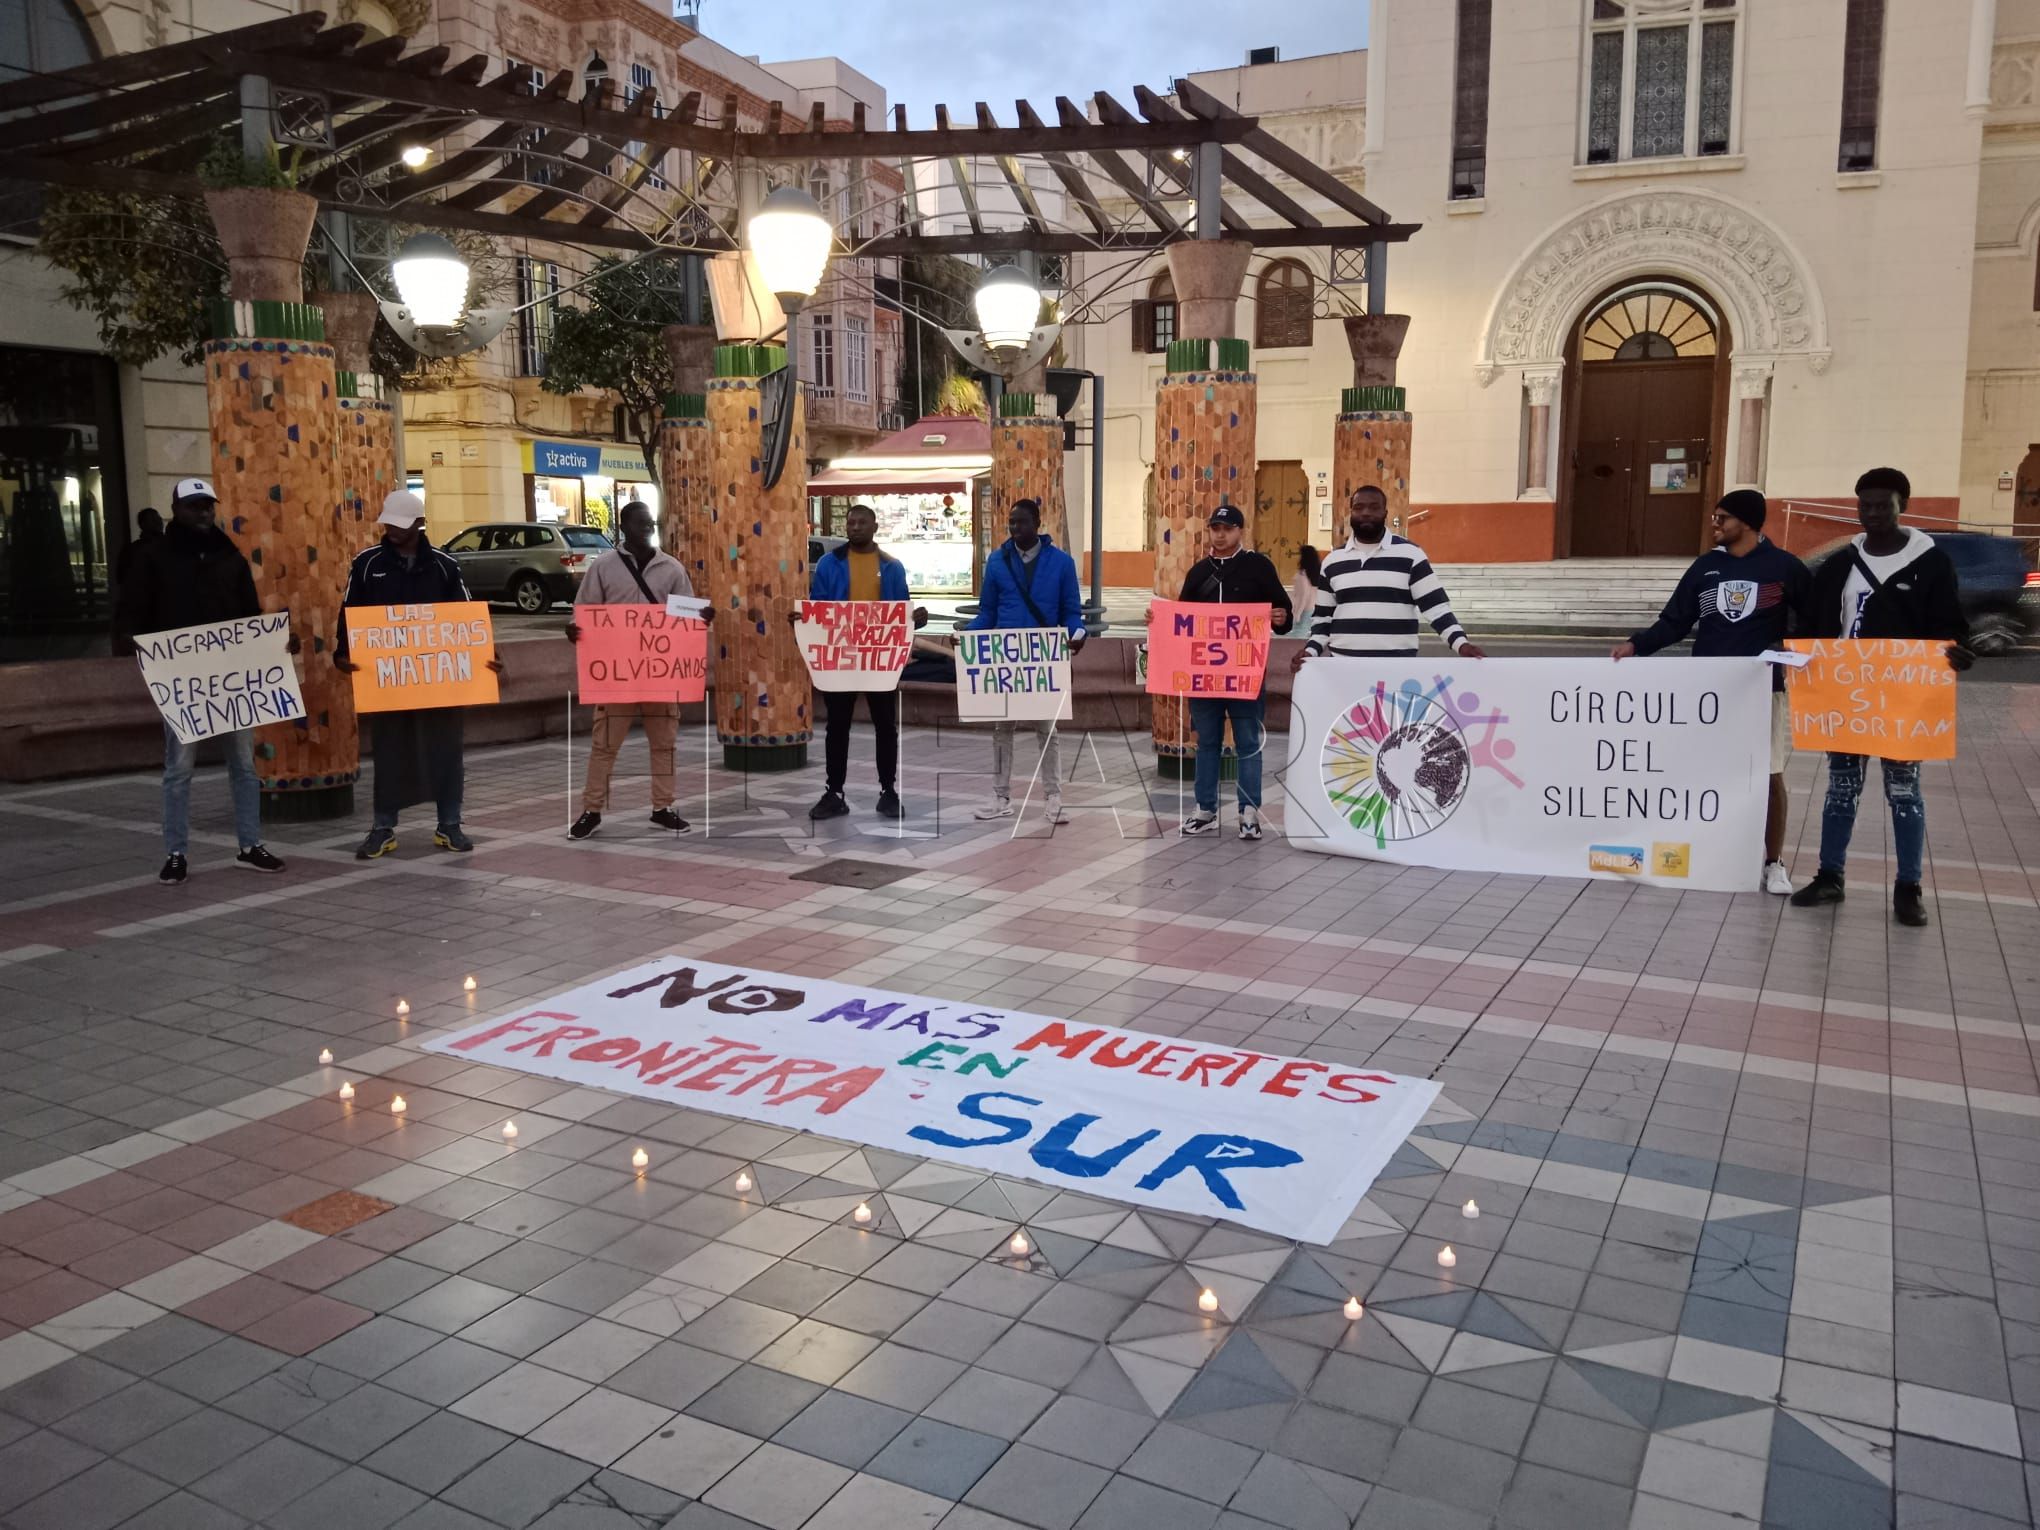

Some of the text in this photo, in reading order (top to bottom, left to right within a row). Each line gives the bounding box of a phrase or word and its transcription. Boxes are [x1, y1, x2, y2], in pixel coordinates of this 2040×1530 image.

[559, 453, 587, 468] activa
[602, 459, 634, 469] MUEBLES
[386, 604, 436, 621] LAS
[801, 601, 906, 625] MEMORIA
[1173, 613, 1266, 640] MIGRAR
[350, 619, 488, 649] FRONTERAS
[640, 631, 671, 654] NO
[822, 624, 911, 647] TARAJAL
[808, 644, 910, 671] JUSTICIA
[1190, 642, 1266, 667] ES UN
[376, 650, 473, 688] MATAN
[966, 666, 1061, 695] TARAJAL
[1172, 671, 1262, 692] DERECHO
[1791, 662, 1954, 687] MIGRANTES
[150, 665, 284, 706] DERECHO
[165, 687, 300, 740] MEMORIA
[1550, 685, 1719, 725] CÍRCULO
[1596, 739, 1665, 772] DEL
[1543, 785, 1720, 822] SILENCIO
[606, 966, 1397, 1104] NO MÁS MUERTES
[897, 1041, 1029, 1079] EN
[447, 1010, 1304, 1211] FRONTERA SUR
